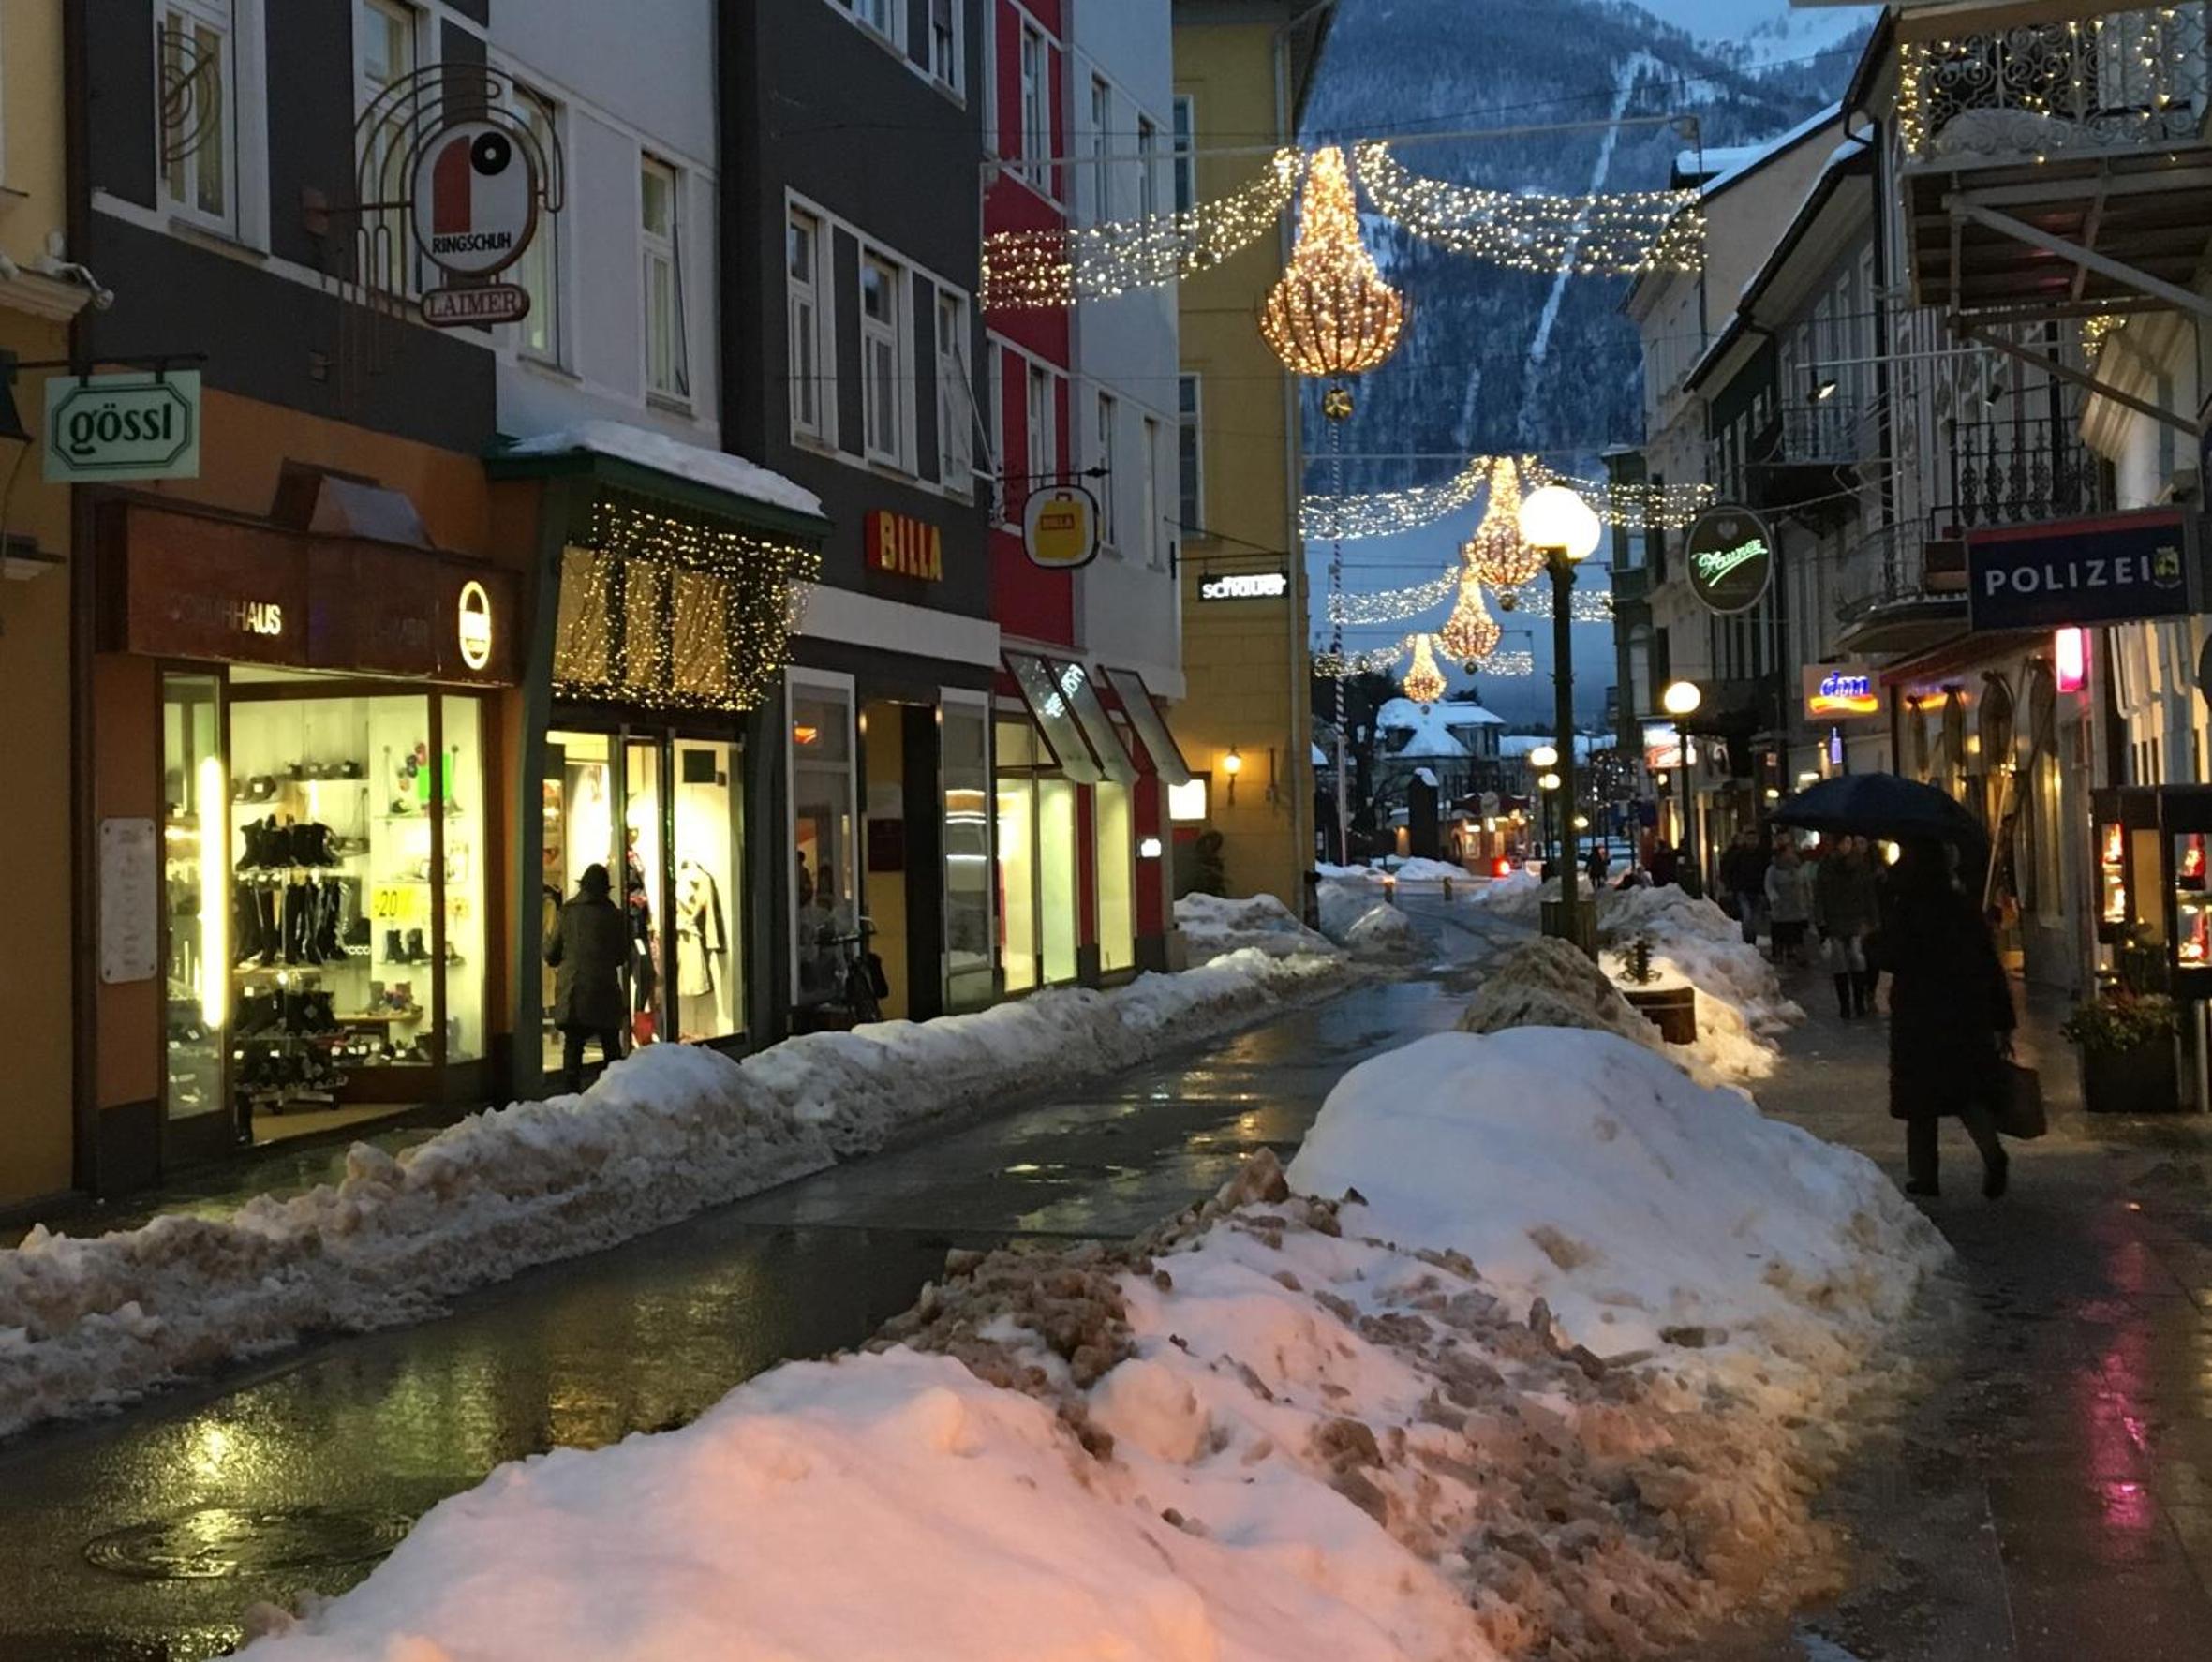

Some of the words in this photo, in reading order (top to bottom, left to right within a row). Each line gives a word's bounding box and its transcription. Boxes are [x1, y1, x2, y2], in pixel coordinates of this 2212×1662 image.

[432, 232, 512, 254] RINGSCHUH
[430, 290, 519, 318] LAIMER
[69, 402, 171, 455] gössl
[878, 510, 943, 582] BILLA
[1985, 555, 2150, 597] POLIZEI
